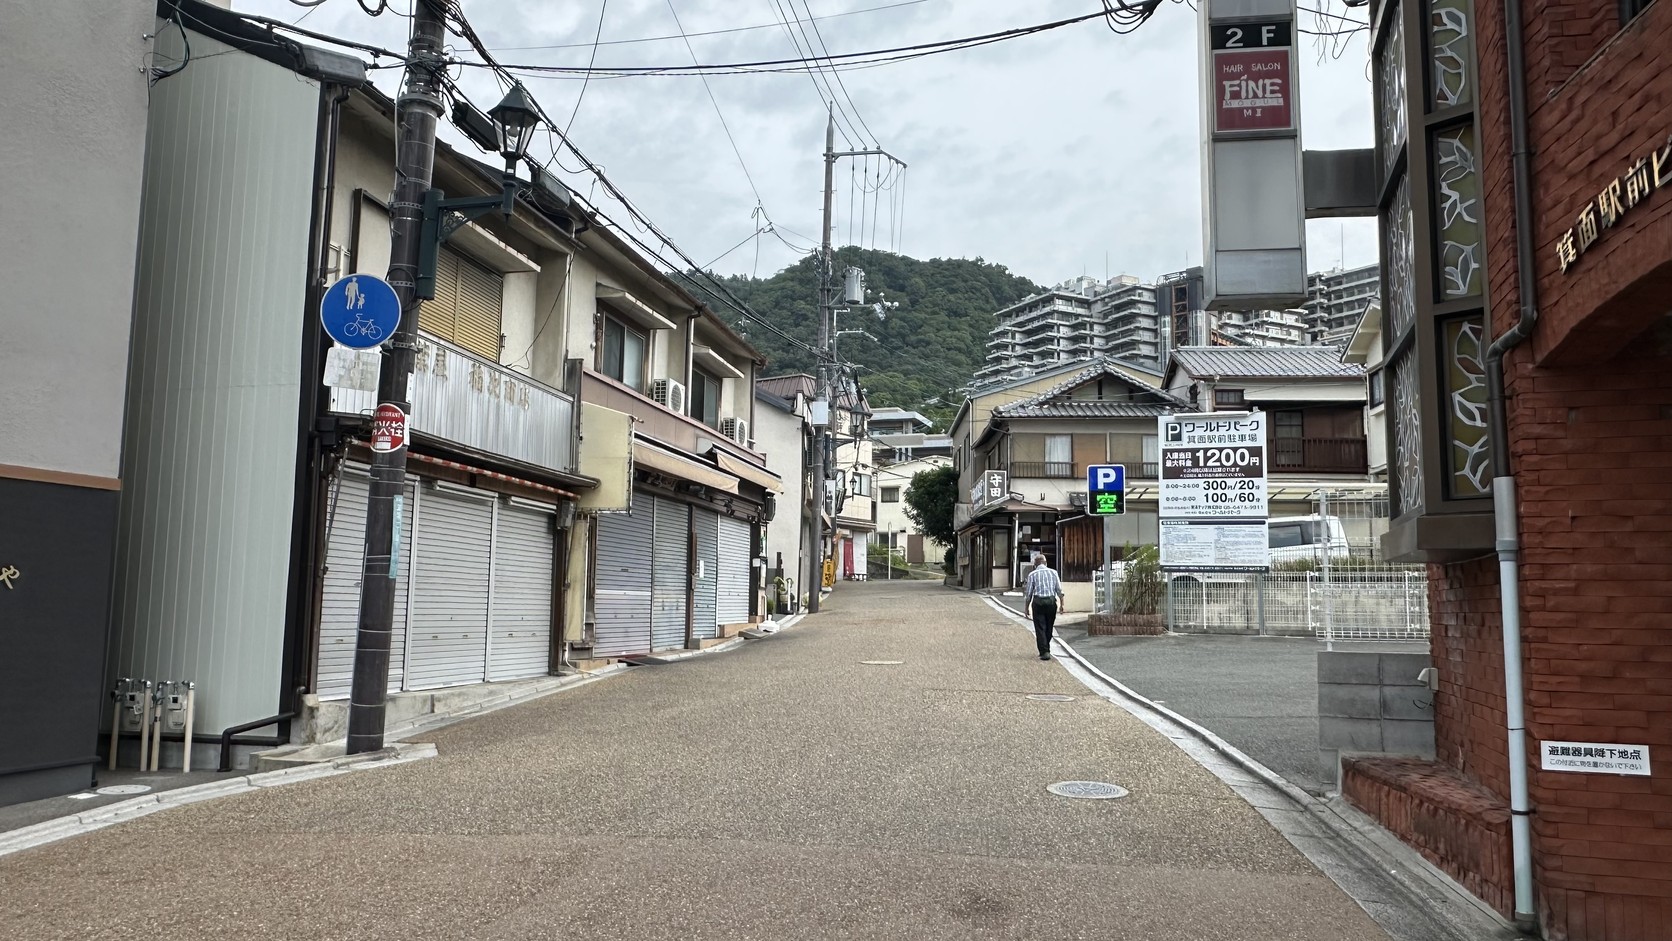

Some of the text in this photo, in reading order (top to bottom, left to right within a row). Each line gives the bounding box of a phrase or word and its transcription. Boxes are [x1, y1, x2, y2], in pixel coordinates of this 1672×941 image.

[1223, 62, 1281, 73] HAIR SALON
[1243, 109, 1252, 117] M
[1167, 423, 1180, 441] P
[1184, 420, 1259, 433] ワールドパーク
[1186, 433, 1258, 444] 箕面駅前駐車場
[1165, 459, 1192, 467] 最大料金
[1195, 448, 1259, 467] 1200円
[989, 473, 1003, 497] 守田
[1097, 468, 1116, 490] P
[1096, 493, 1117, 513] 空
[1548, 745, 1642, 761] 避難器具降下地点
[1549, 758, 1642, 770] この付近に物を置かないで下さい
